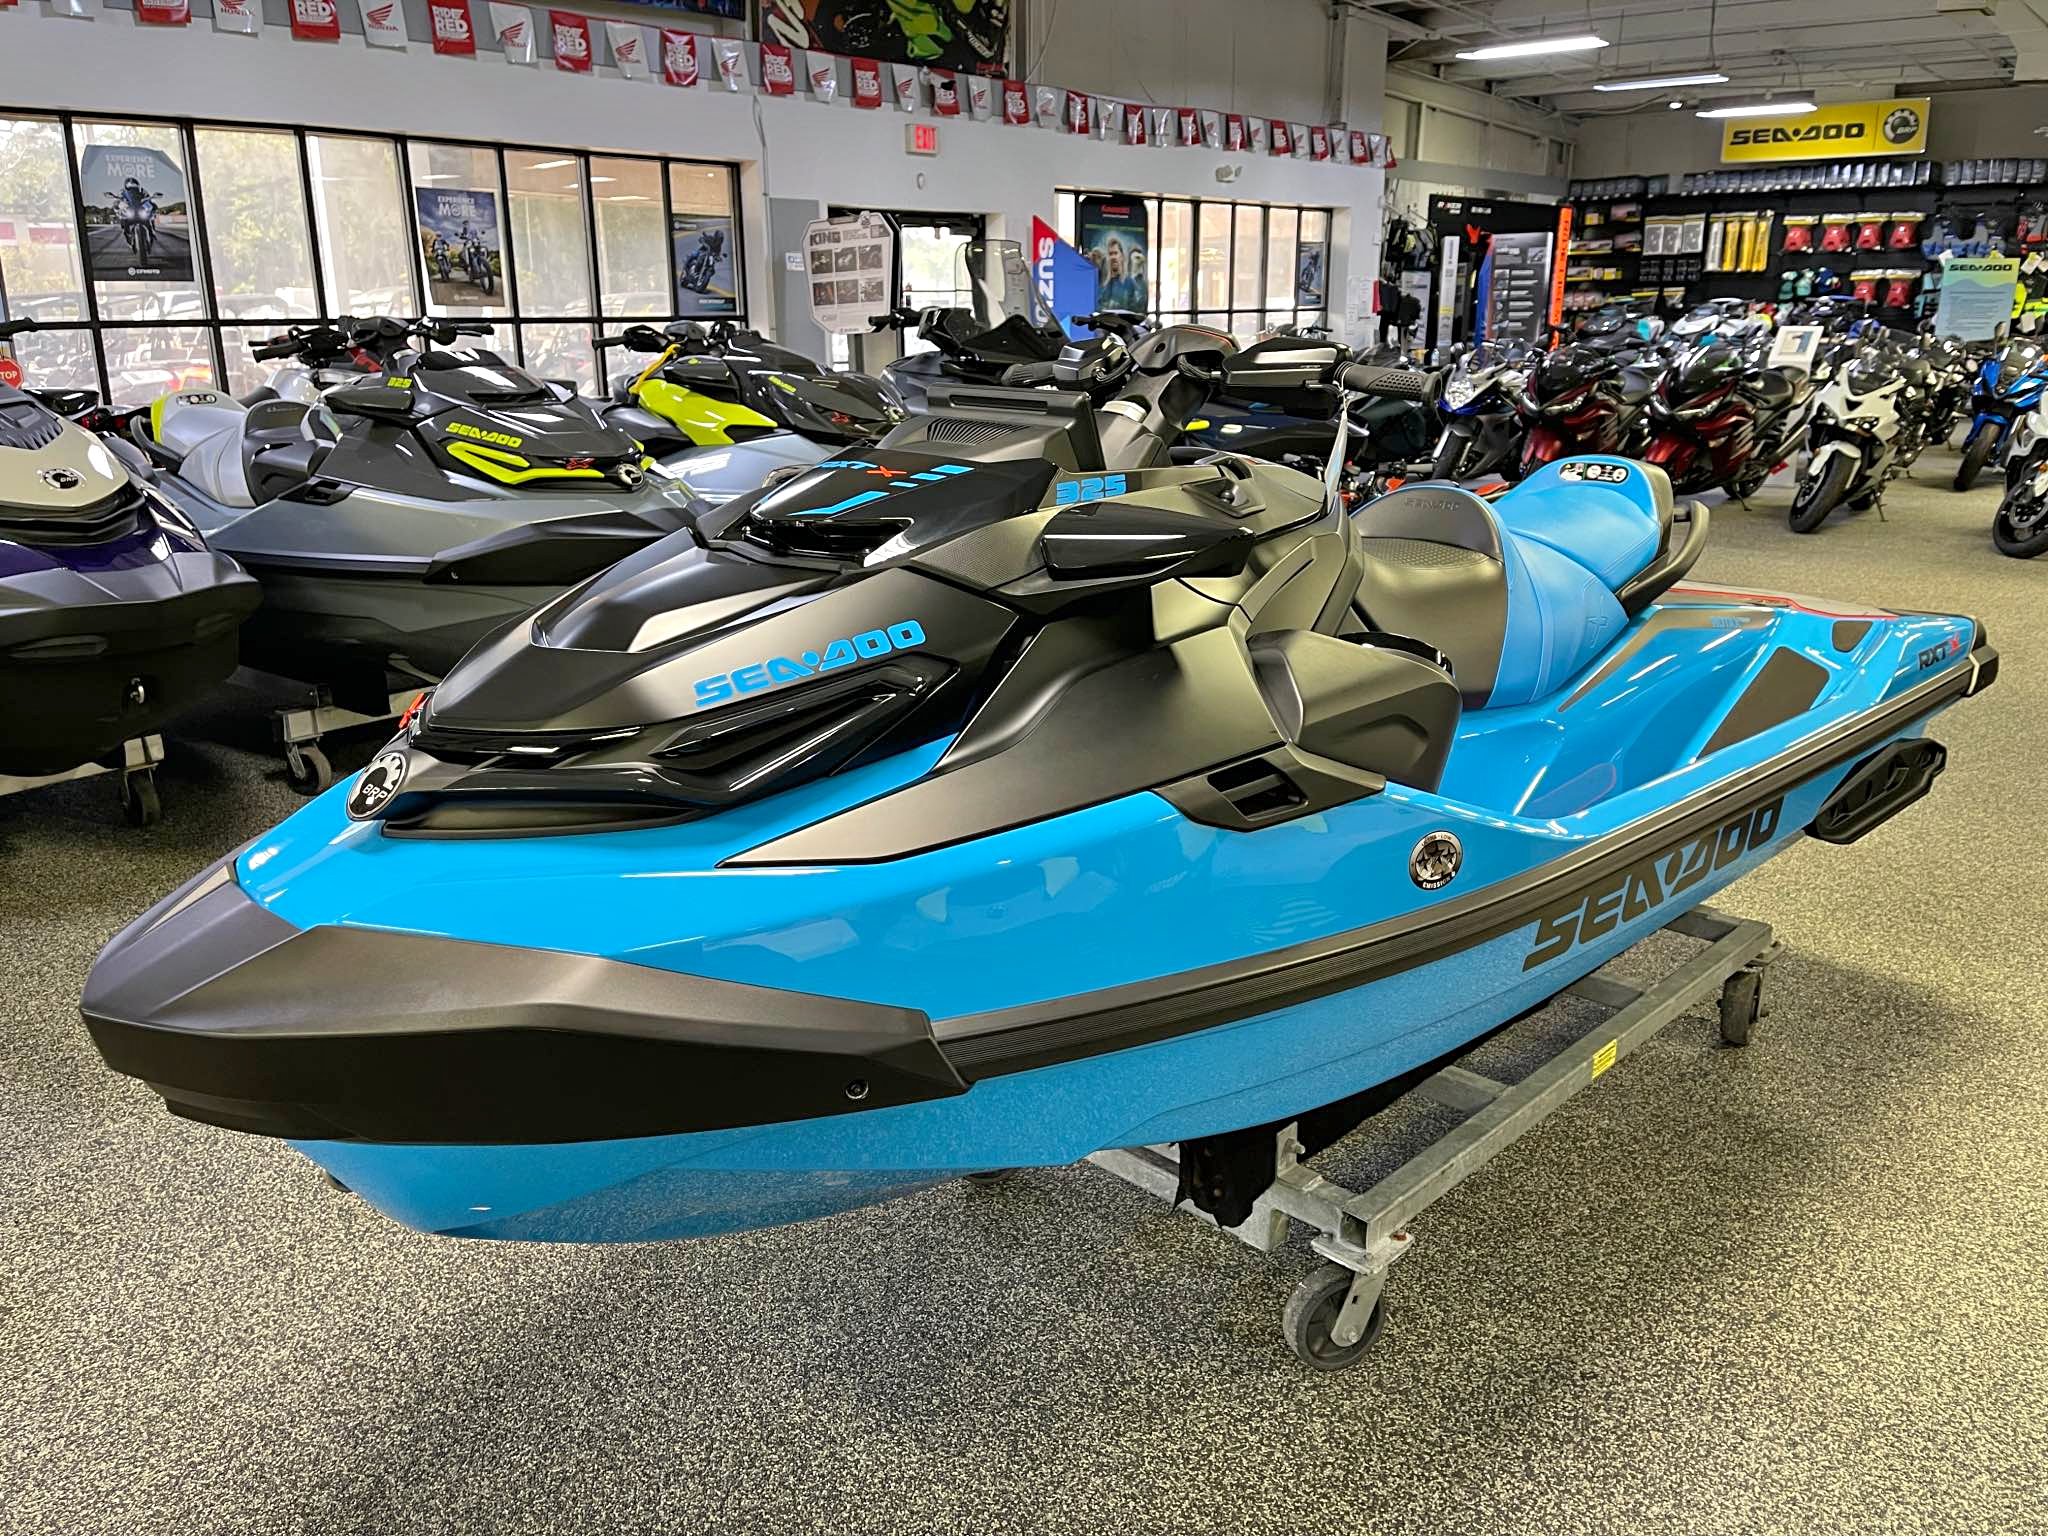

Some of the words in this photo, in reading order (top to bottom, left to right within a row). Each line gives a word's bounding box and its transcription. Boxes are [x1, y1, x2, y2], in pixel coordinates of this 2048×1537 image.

[298, 2, 331, 18] RED
[435, 19, 469, 34] RED
[557, 36, 587, 51] RED
[915, 126, 936, 150] EXIT
[809, 231, 842, 247] KING
[0, 371, 18, 380] TOP
[1056, 473, 1127, 506] 325
[1918, 639, 1950, 672] RXT
[361, 783, 389, 801] BRP
